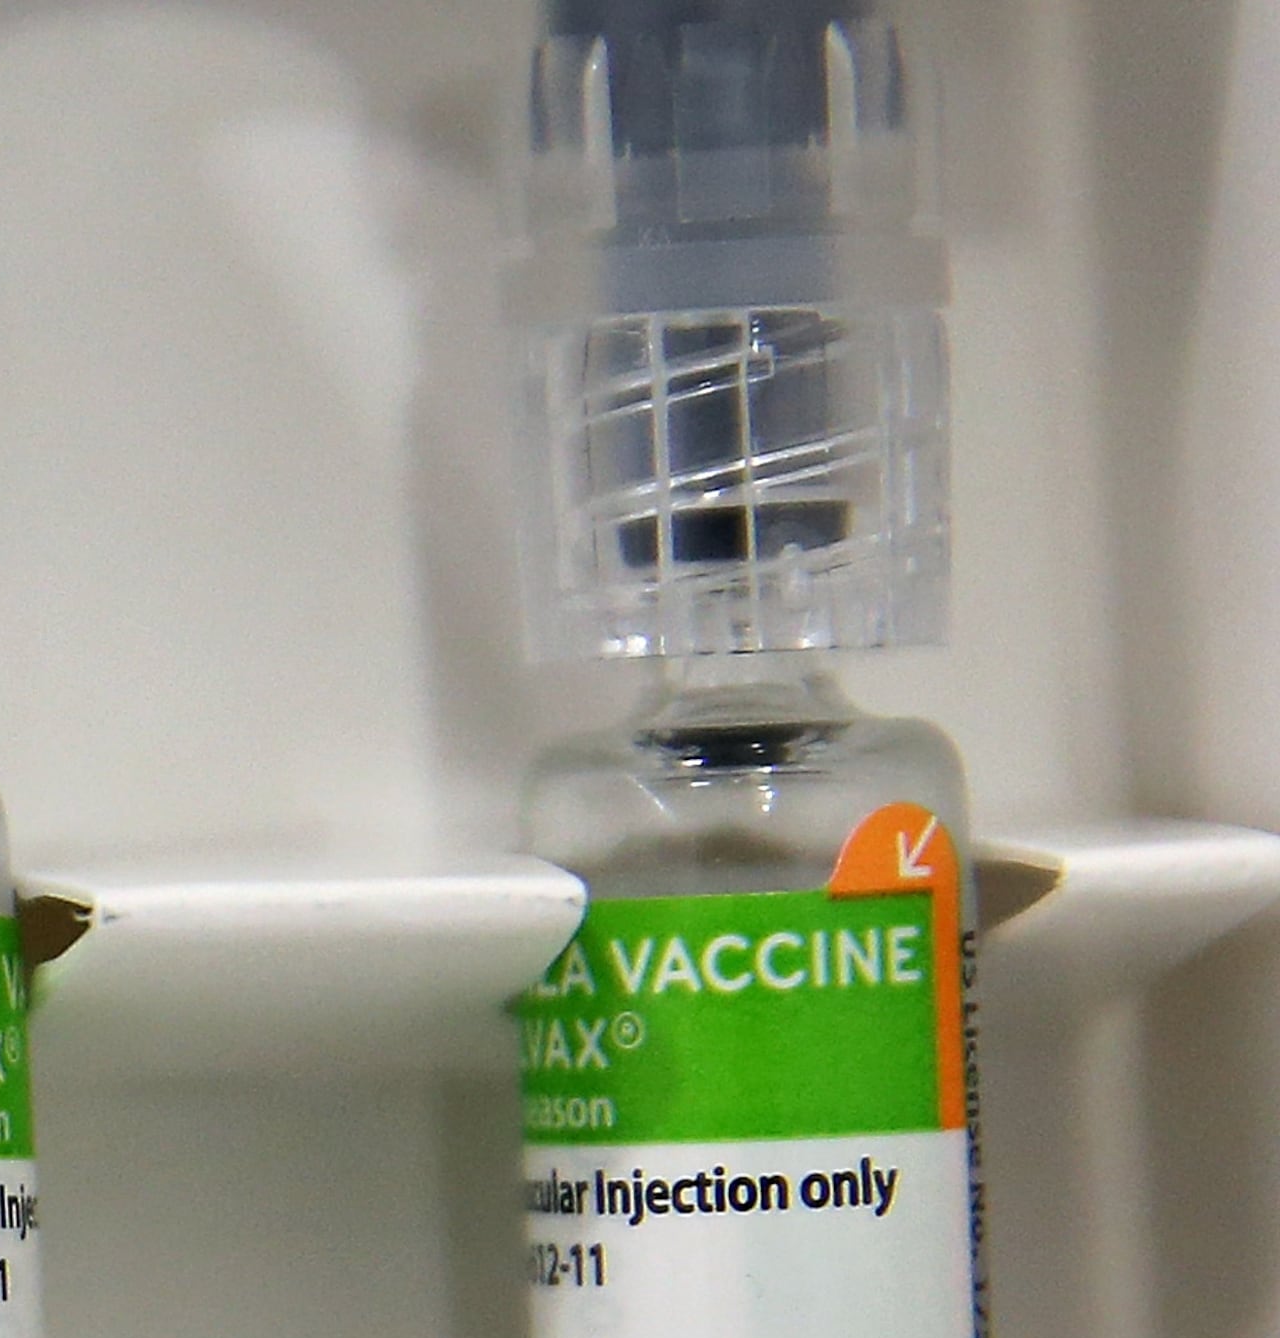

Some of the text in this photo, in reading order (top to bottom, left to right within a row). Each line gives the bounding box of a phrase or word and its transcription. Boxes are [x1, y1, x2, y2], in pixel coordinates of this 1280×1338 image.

[611, 925, 922, 995] VACCINE
[596, 1167, 789, 1226] Injection
[800, 1157, 898, 1218] only
